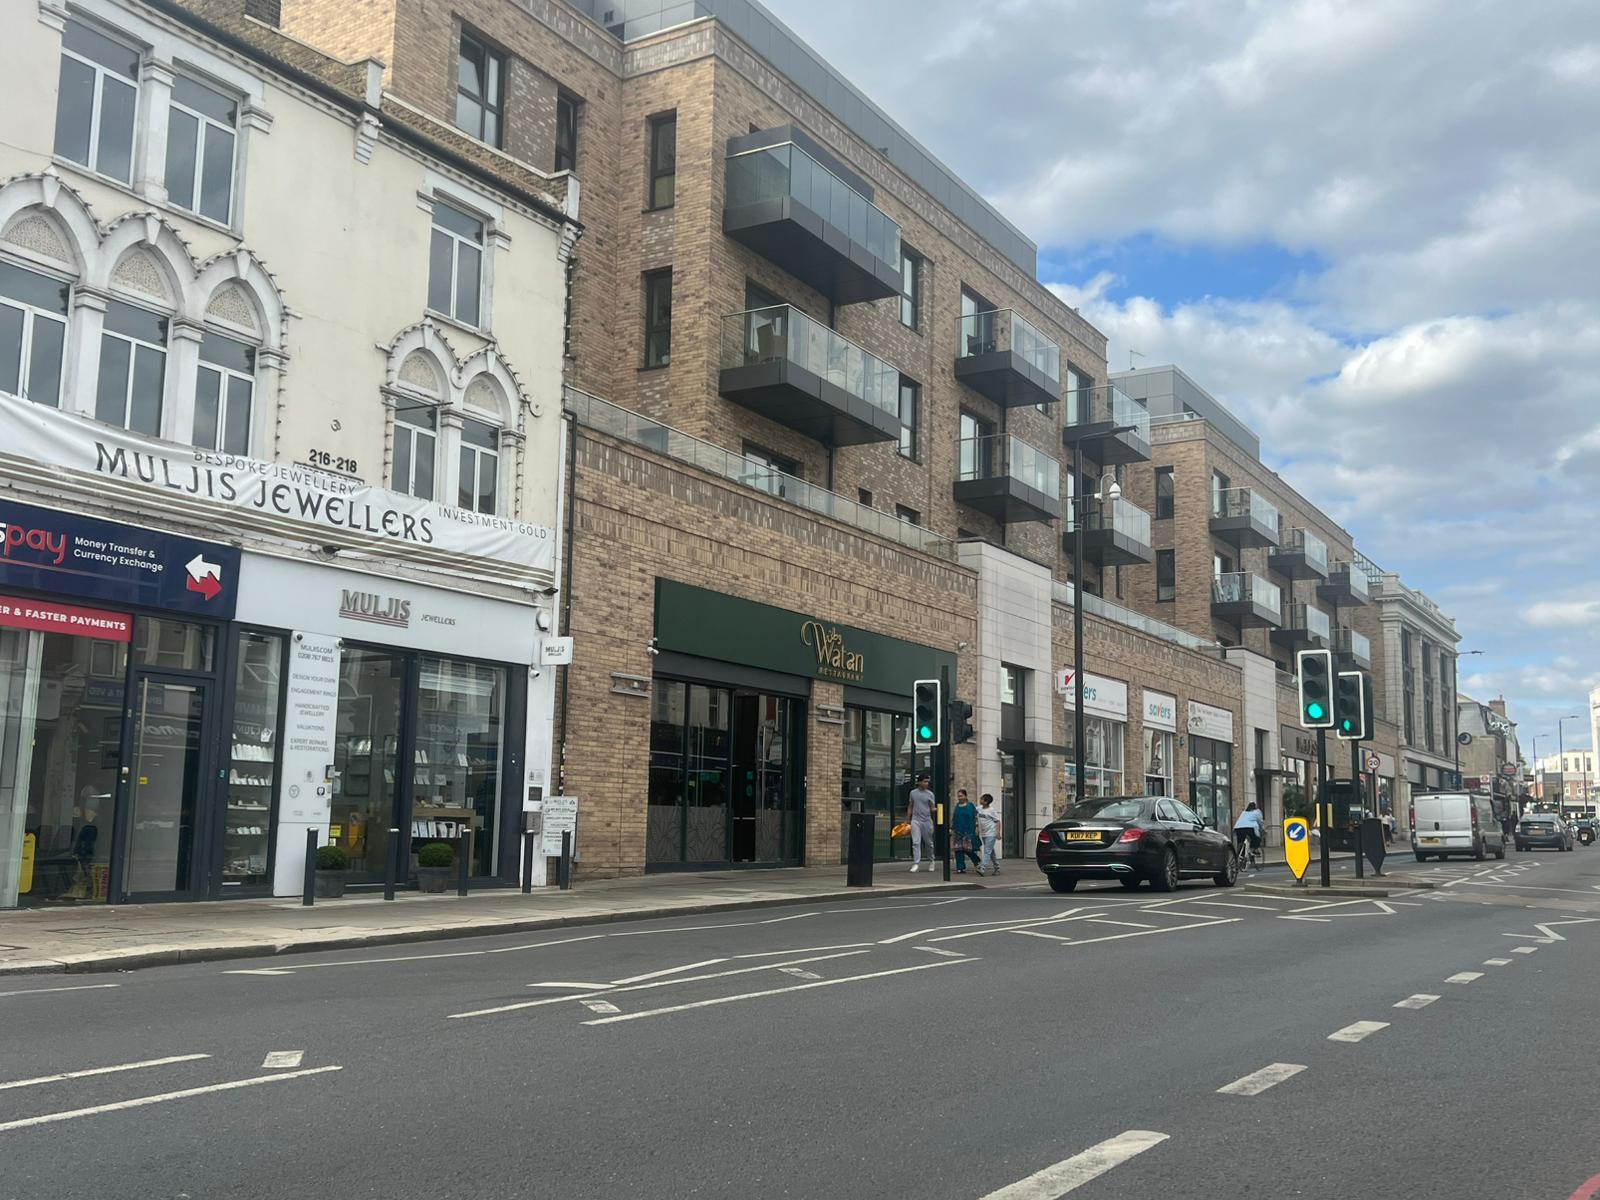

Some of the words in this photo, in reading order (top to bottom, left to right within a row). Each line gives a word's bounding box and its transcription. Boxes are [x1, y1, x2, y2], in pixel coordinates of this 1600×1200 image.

[309, 448, 357, 473] 216-218
[94, 441, 237, 501] MULJIS
[253, 479, 433, 543] JEWELLERS
[273, 466, 355, 495] JEWELLERY
[438, 505, 515, 532] INVESTMENT
[518, 523, 547, 539] GOLD
[75, 537, 107, 552] Money
[108, 542, 148, 558] Transfer
[148, 550, 156, 559] &
[73, 549, 118, 566] Currency
[119, 556, 163, 573] Exchange
[14, 607, 22, 616] &
[25, 609, 68, 623] FASTER
[70, 615, 126, 631] PAYMENTS
[341, 589, 410, 620] MULJIS
[421, 614, 456, 626] JEWELLERS
[801, 620, 864, 673] Watan
[291, 687, 322, 695] ENGAGEMENT
[1149, 703, 1171, 720] savers
